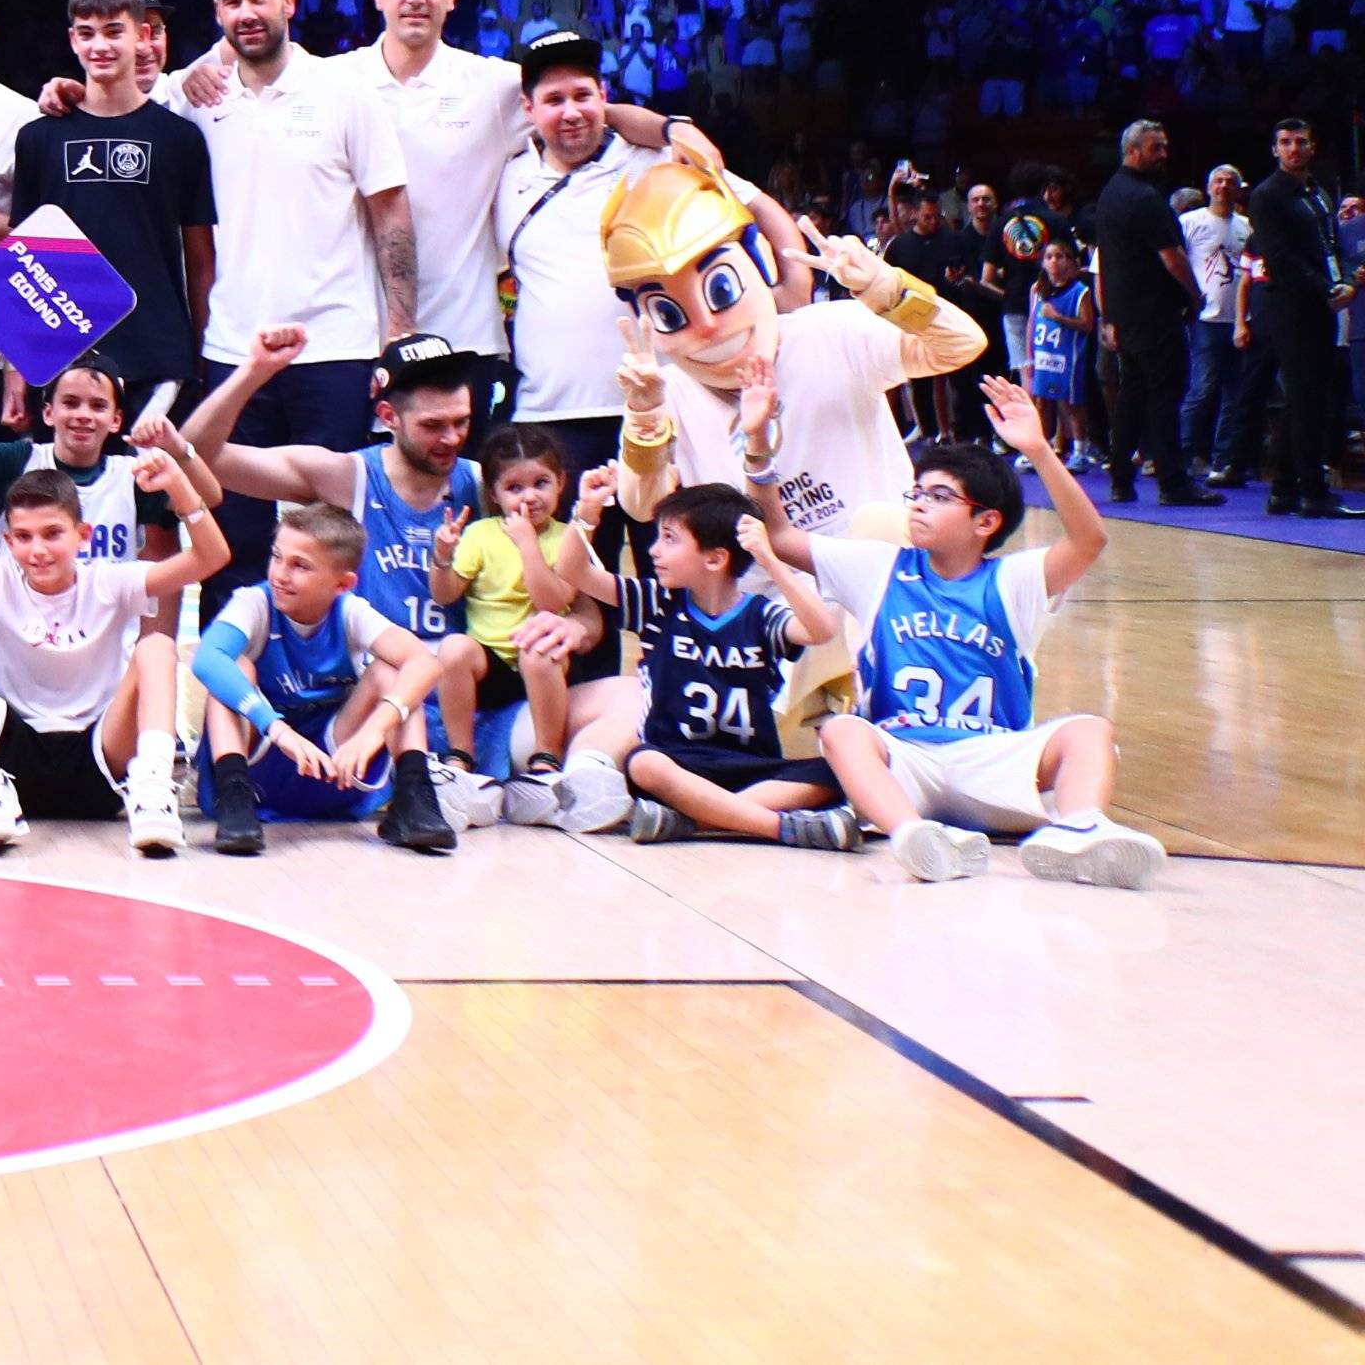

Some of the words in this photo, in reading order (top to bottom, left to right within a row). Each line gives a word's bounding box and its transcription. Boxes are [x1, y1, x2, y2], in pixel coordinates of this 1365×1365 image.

[8, 241, 58, 296] PARIS
[50, 289, 93, 336] 2024
[8, 272, 62, 331] BOUND
[1034, 323, 1062, 349] 34
[375, 544, 431, 573] HELL
[403, 595, 446, 633] 16
[890, 610, 1005, 658] HELLAS
[679, 681, 756, 746] 34
[893, 666, 994, 730] 34
